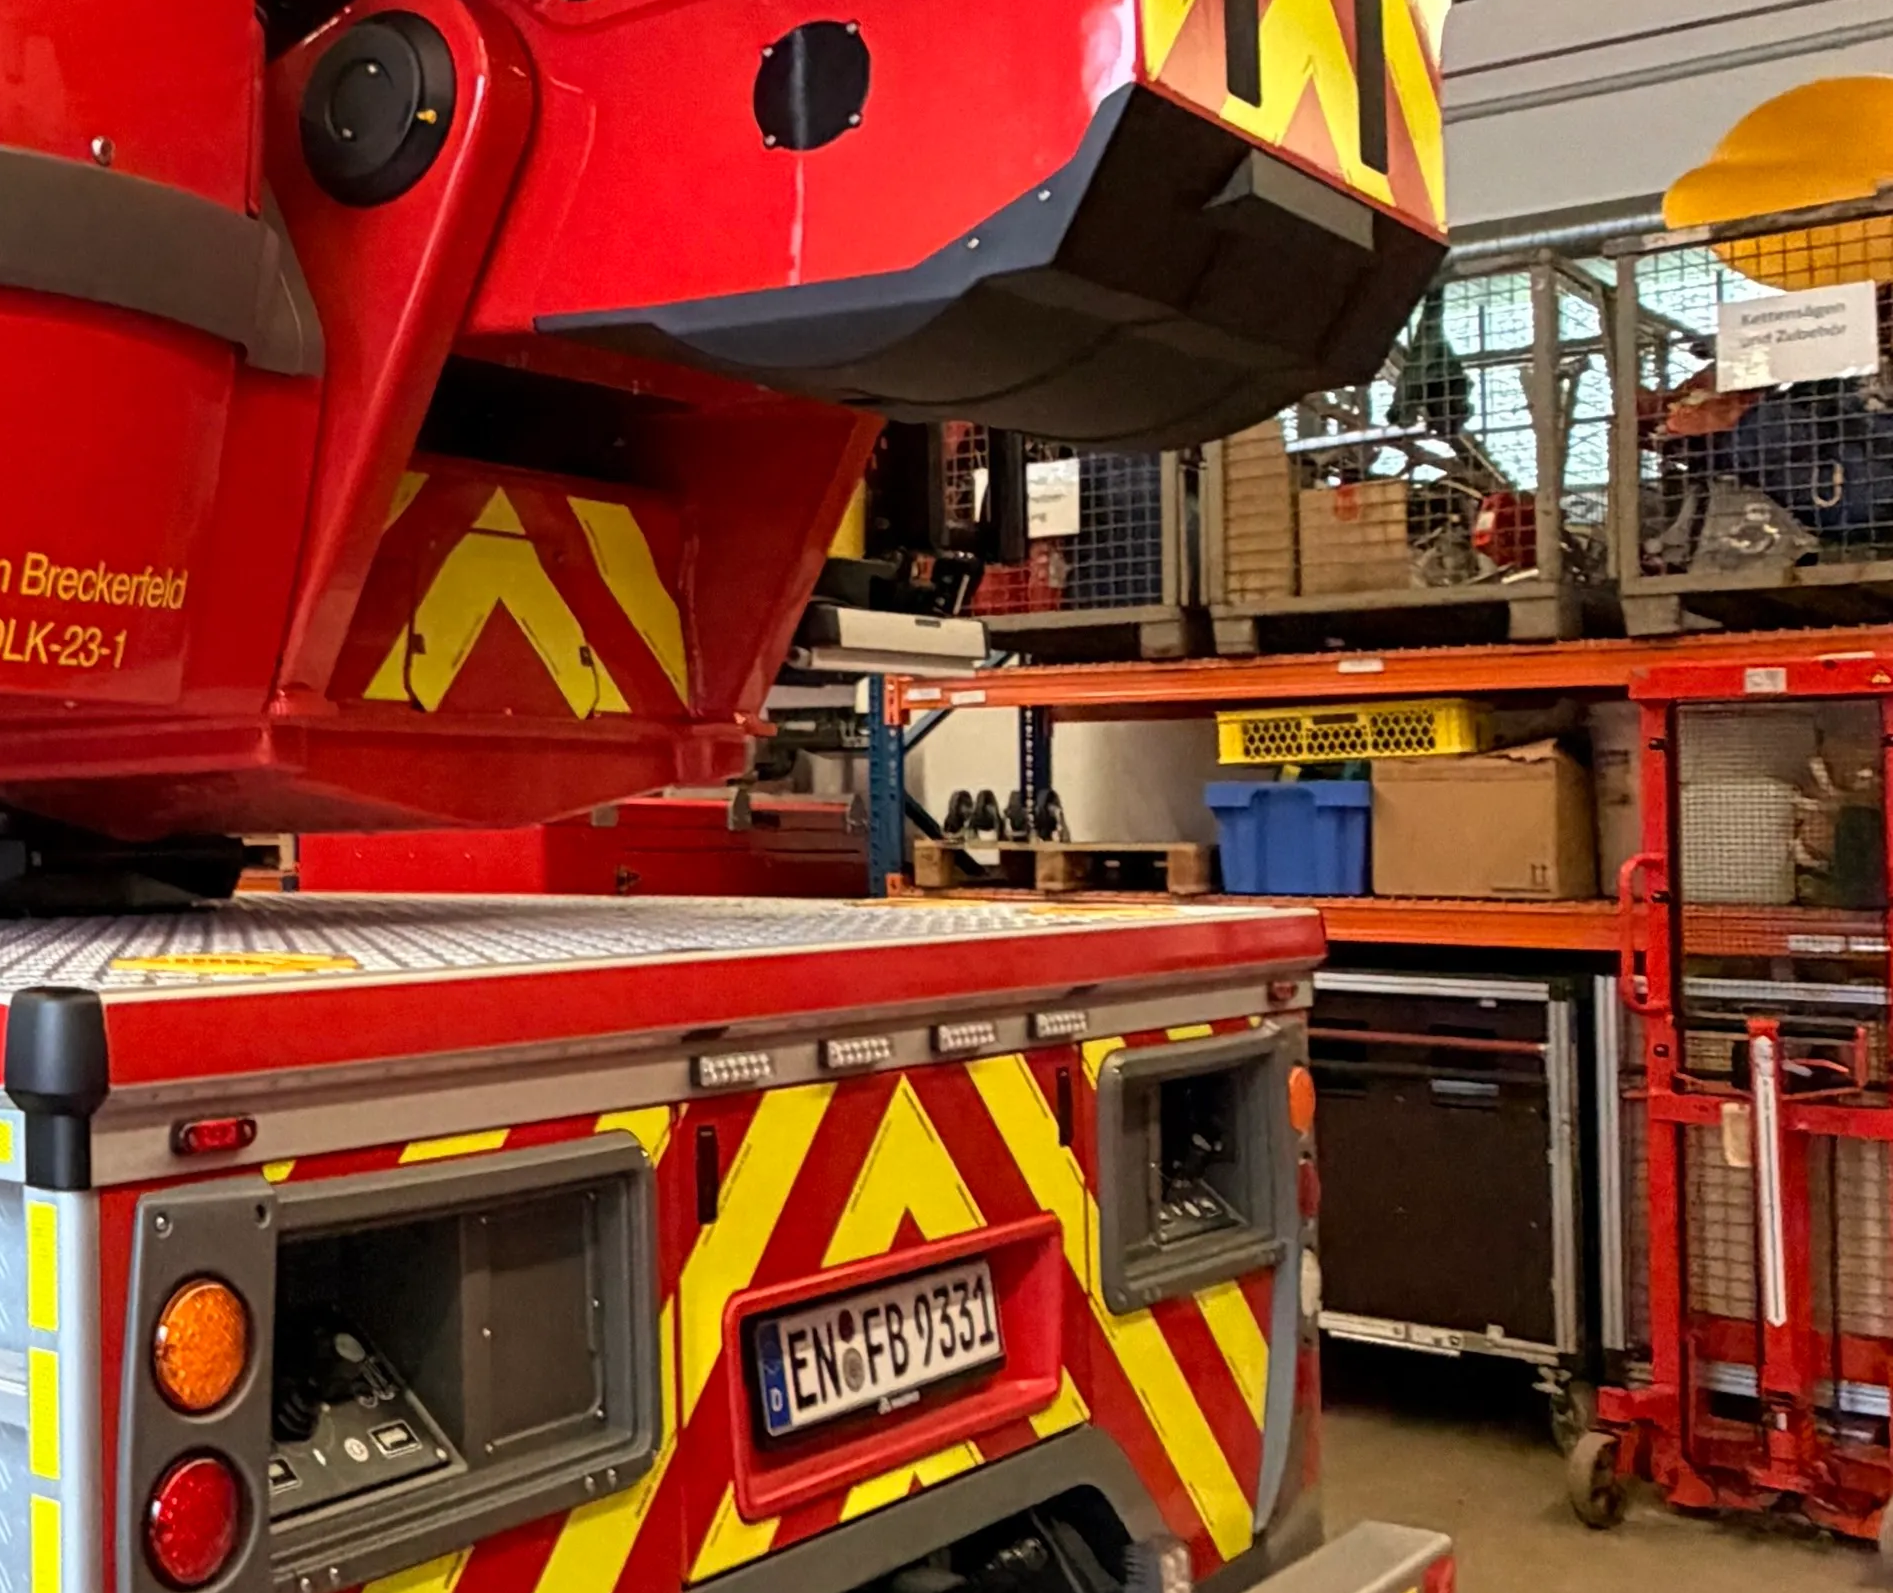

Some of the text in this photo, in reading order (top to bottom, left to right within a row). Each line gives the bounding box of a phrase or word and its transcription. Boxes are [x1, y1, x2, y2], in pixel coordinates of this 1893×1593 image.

[20, 551, 189, 609] Breckerfeld
[787, 1274, 995, 1411] EN FB 9331
